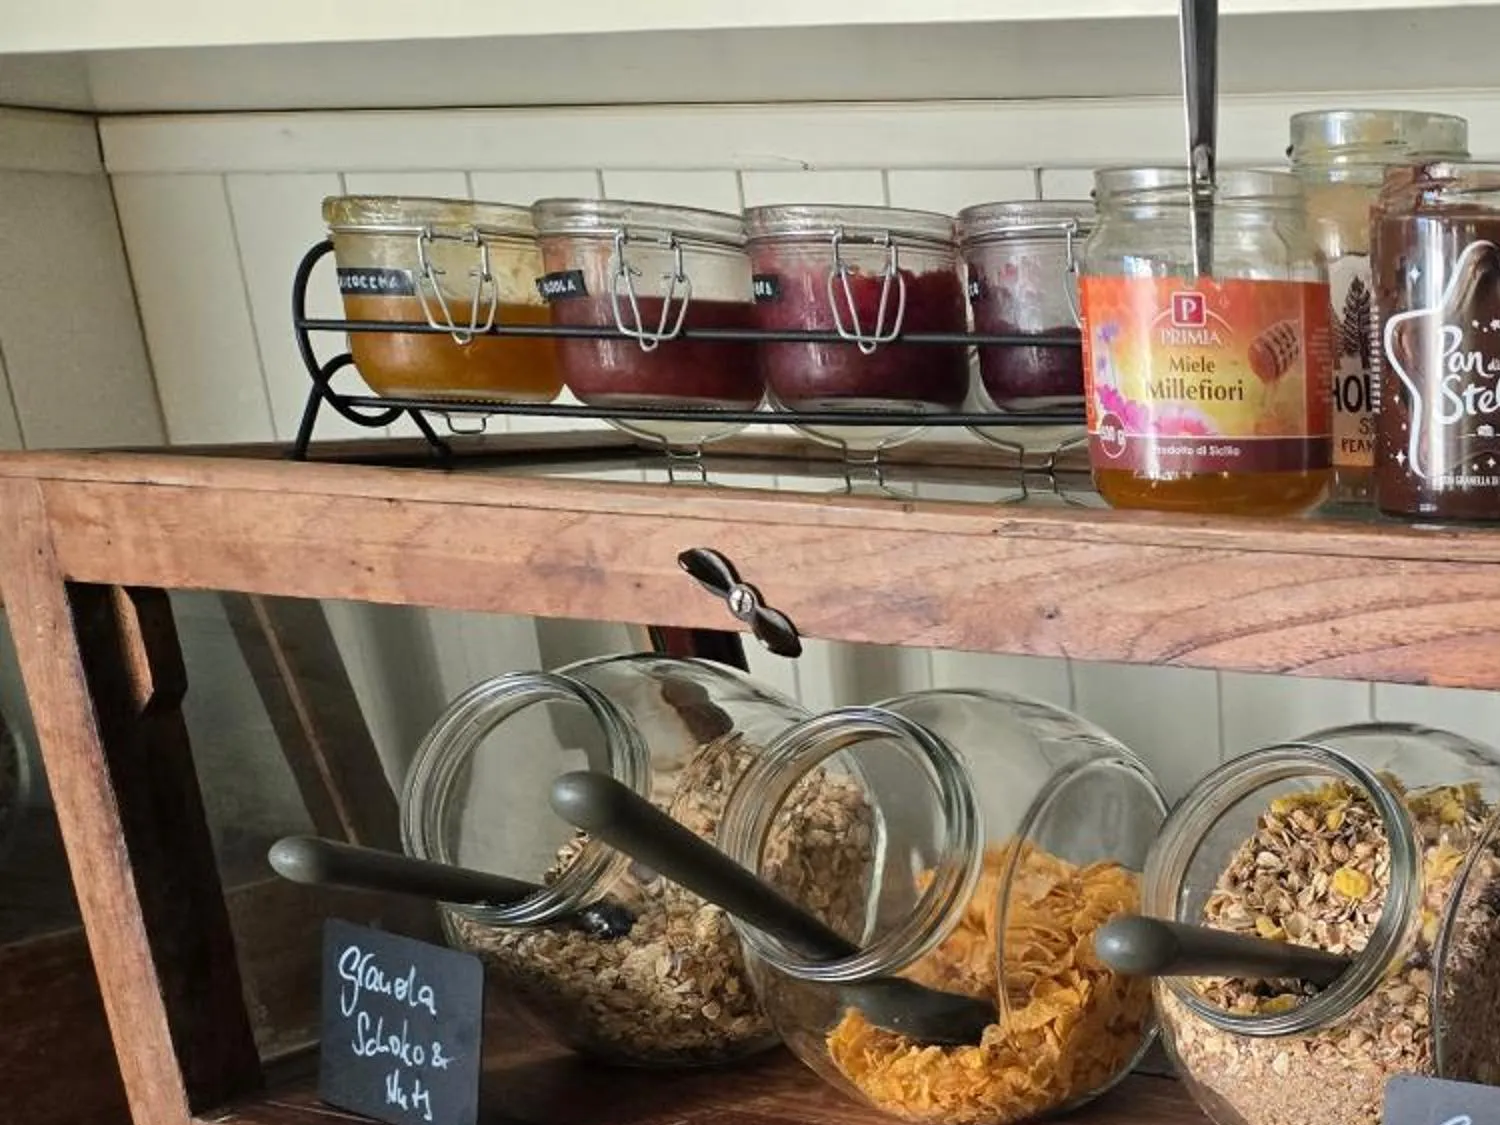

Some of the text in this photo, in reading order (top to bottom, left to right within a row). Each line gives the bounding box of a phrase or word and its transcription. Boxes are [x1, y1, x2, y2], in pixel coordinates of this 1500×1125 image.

[1169, 355, 1216, 373] Miele
[1437, 325, 1494, 378] Pan
[1146, 379, 1244, 401] Millefiori
[352, 1011, 425, 1067] Schoko
[386, 1068, 433, 1121] Nuts
